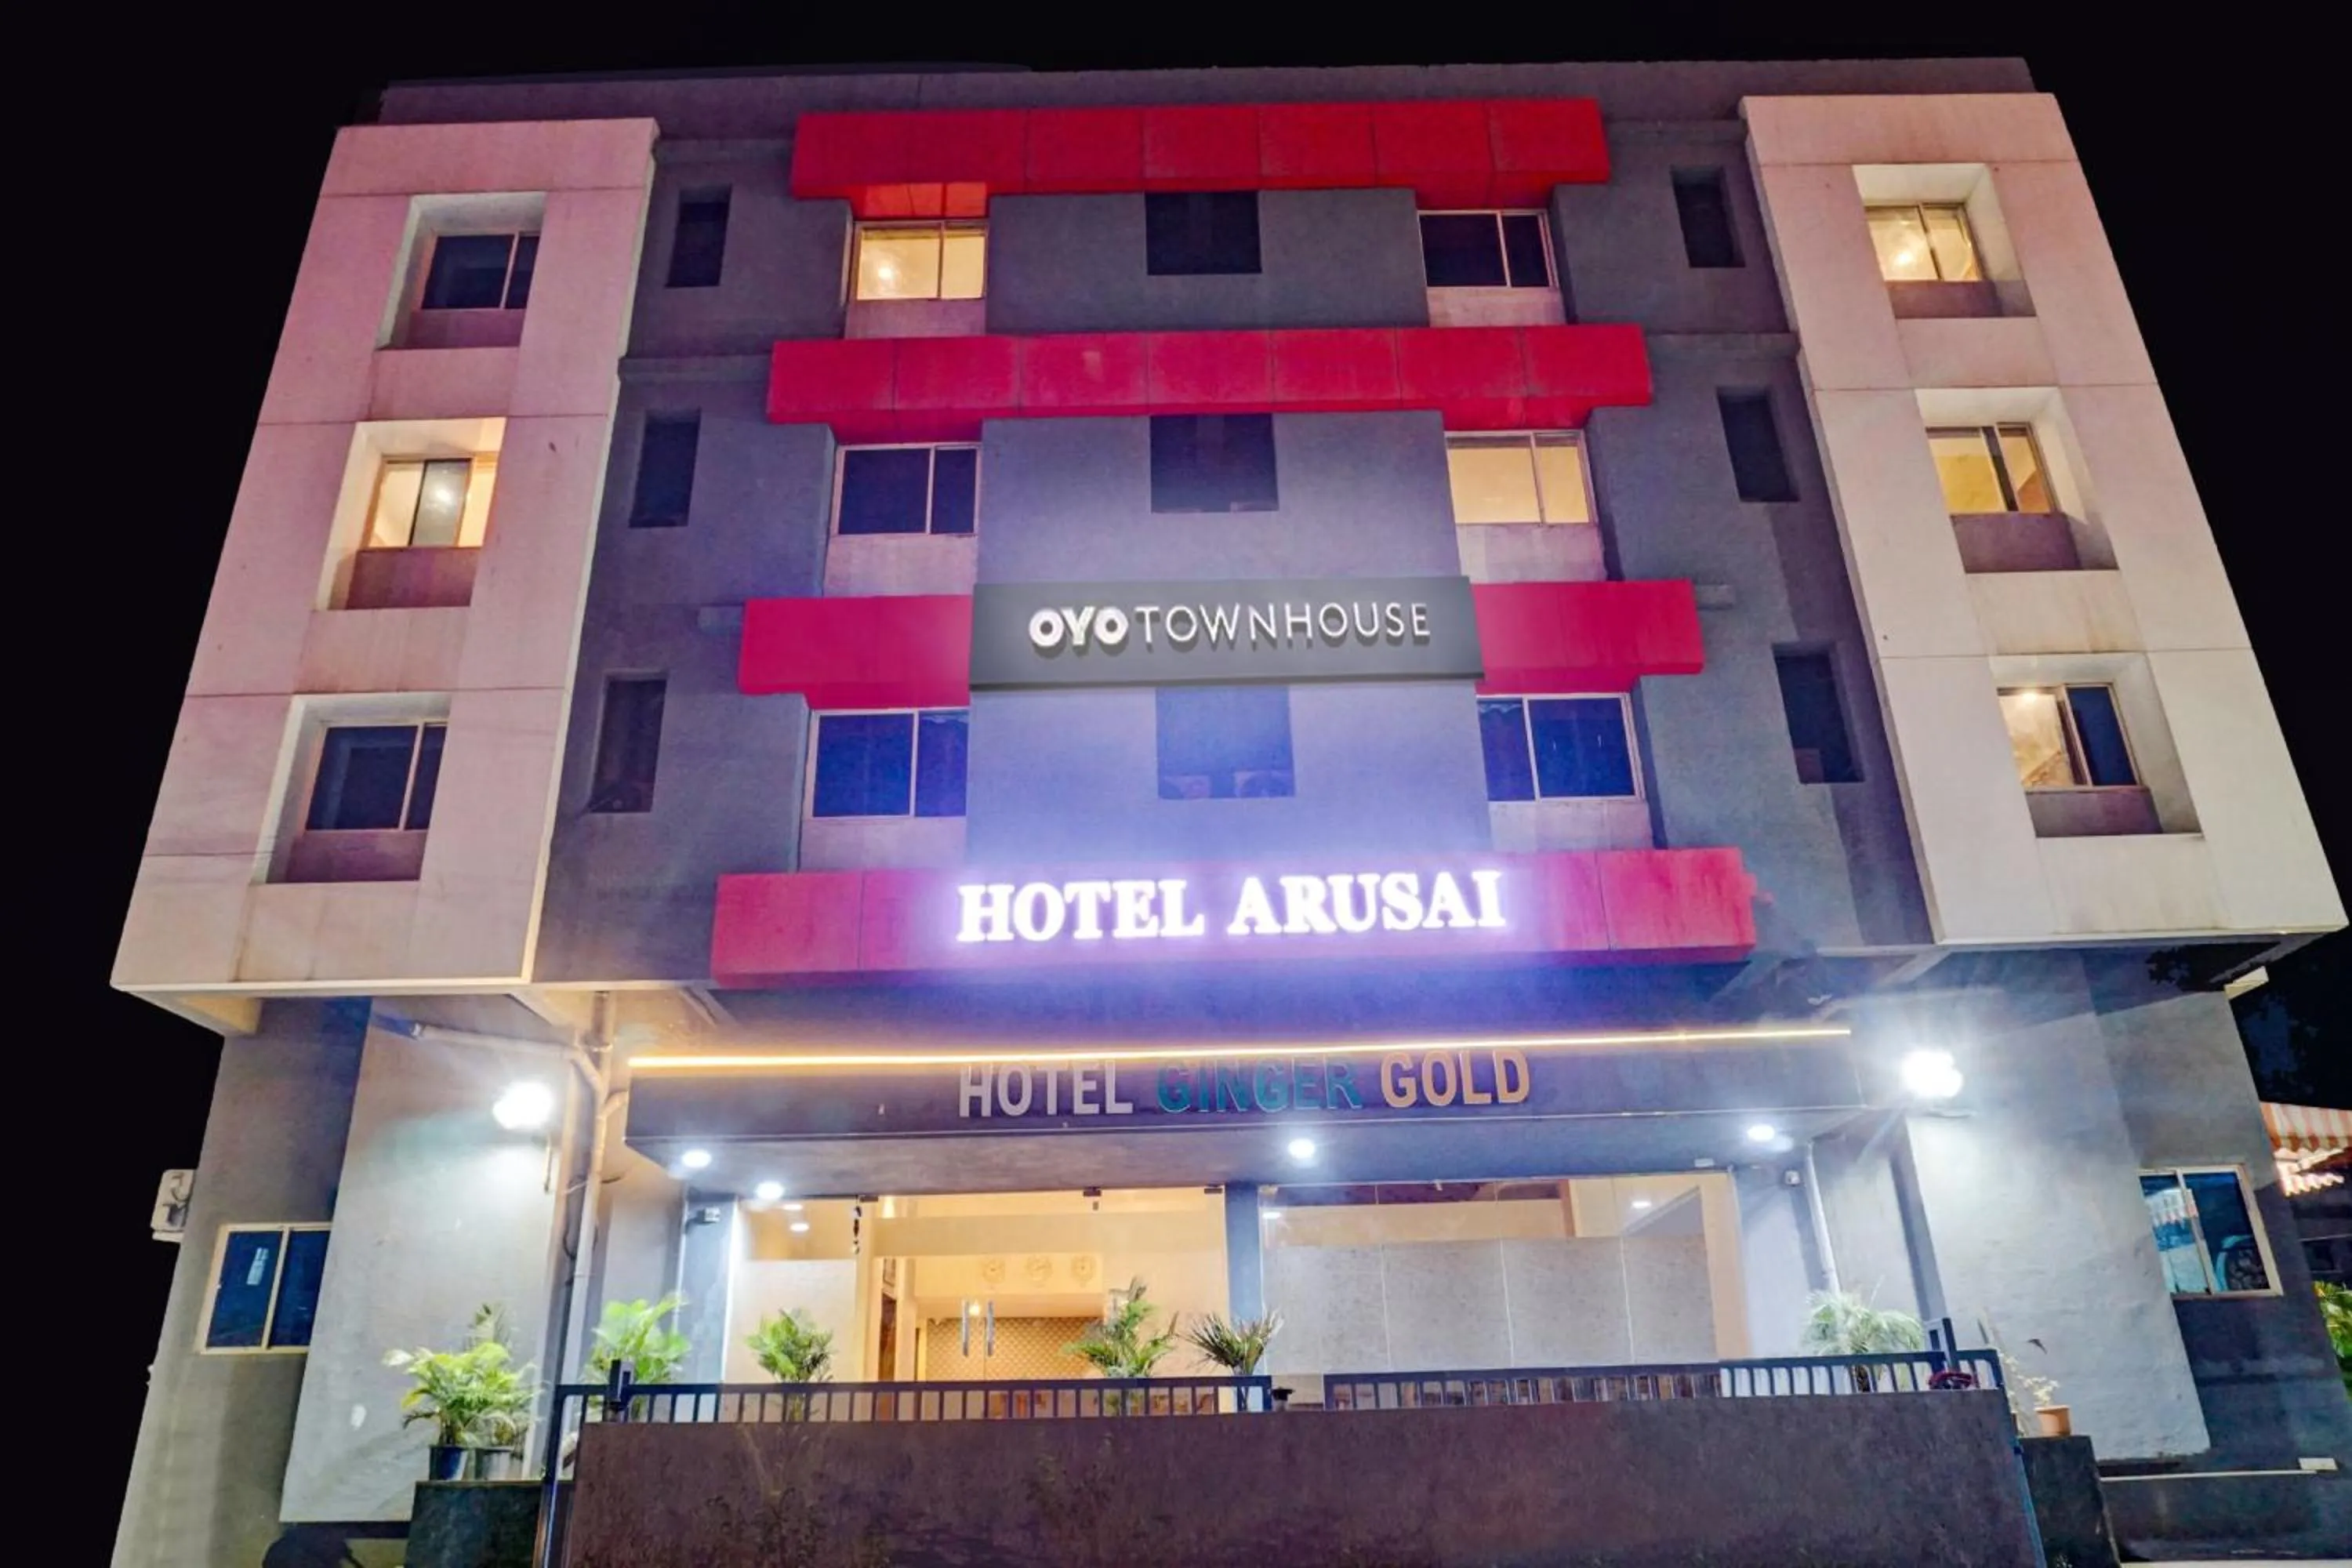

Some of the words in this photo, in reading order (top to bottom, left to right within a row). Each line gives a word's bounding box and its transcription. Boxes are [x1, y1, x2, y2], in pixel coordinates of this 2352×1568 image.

[1029, 605, 1129, 647] OYO
[1135, 601, 1432, 644] TOWNHOUSE
[956, 877, 1206, 942] HOTEL
[1226, 869, 1507, 936] ARUSAI
[958, 1059, 1134, 1118] HOTEL
[1156, 1055, 1363, 1113] GINGER
[1380, 1048, 1531, 1109] GOLD
